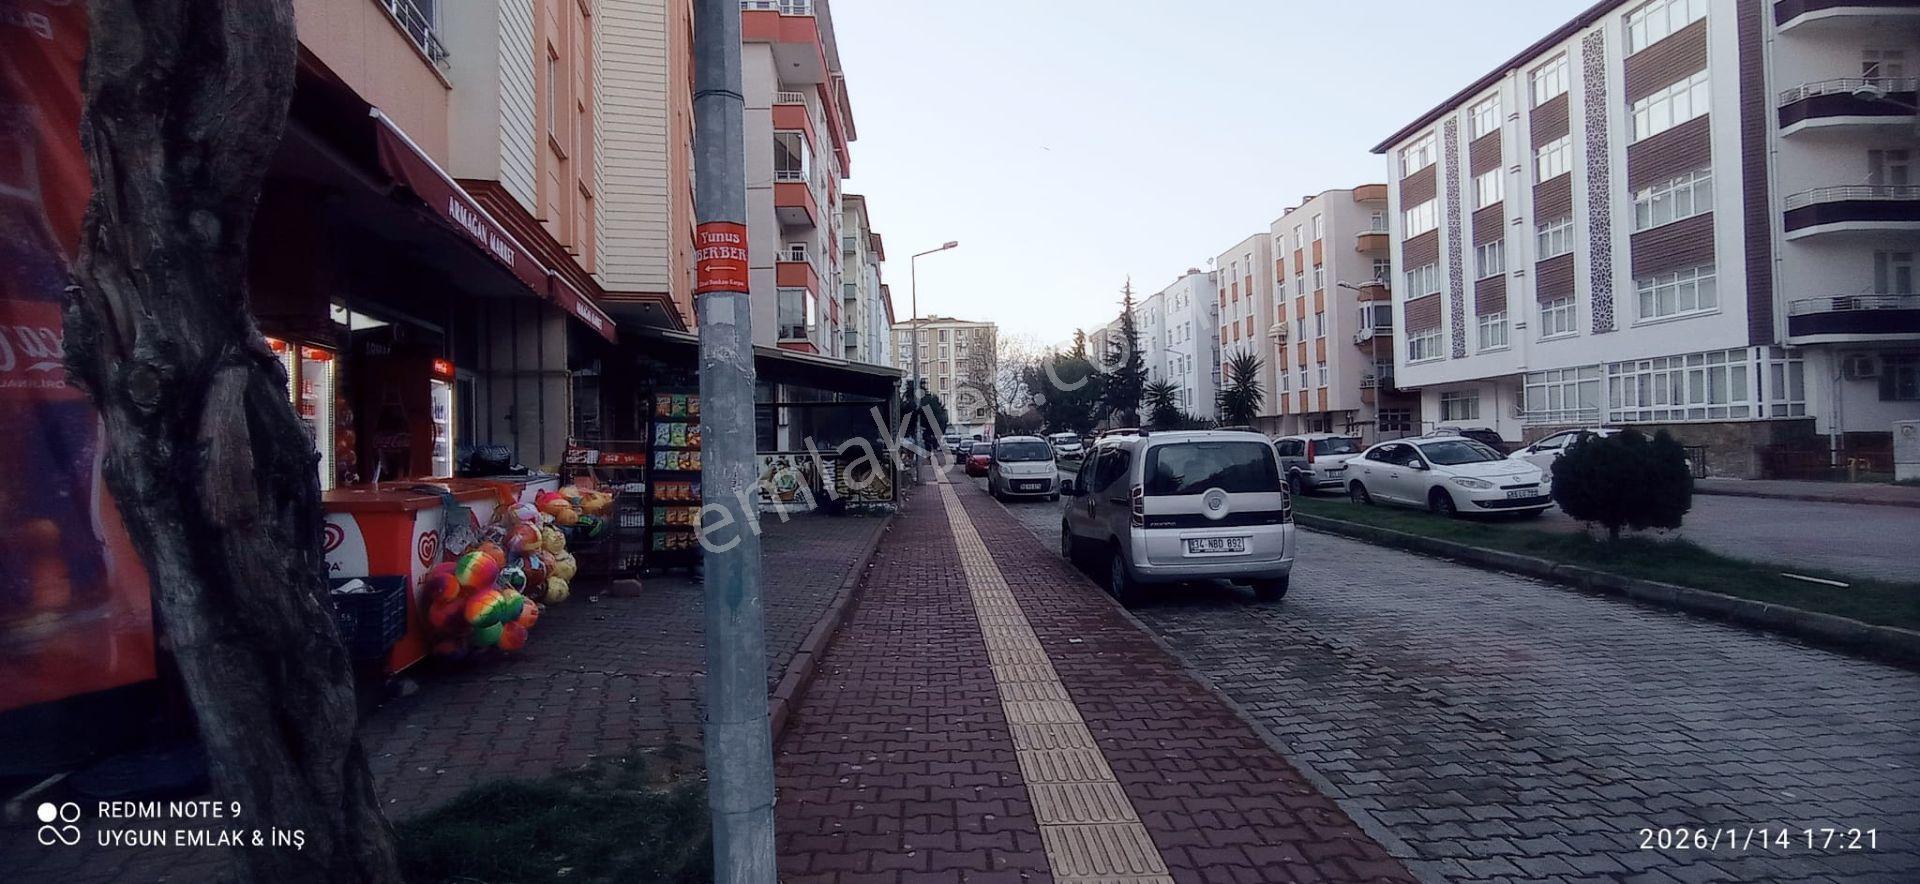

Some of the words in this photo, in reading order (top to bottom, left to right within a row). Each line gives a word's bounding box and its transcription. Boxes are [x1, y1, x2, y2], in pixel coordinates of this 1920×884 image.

[449, 196, 488, 246] ARMAĞAN
[490, 232, 515, 268] MARKET
[701, 232, 740, 244] Yunus
[696, 247, 747, 261] BERBER
